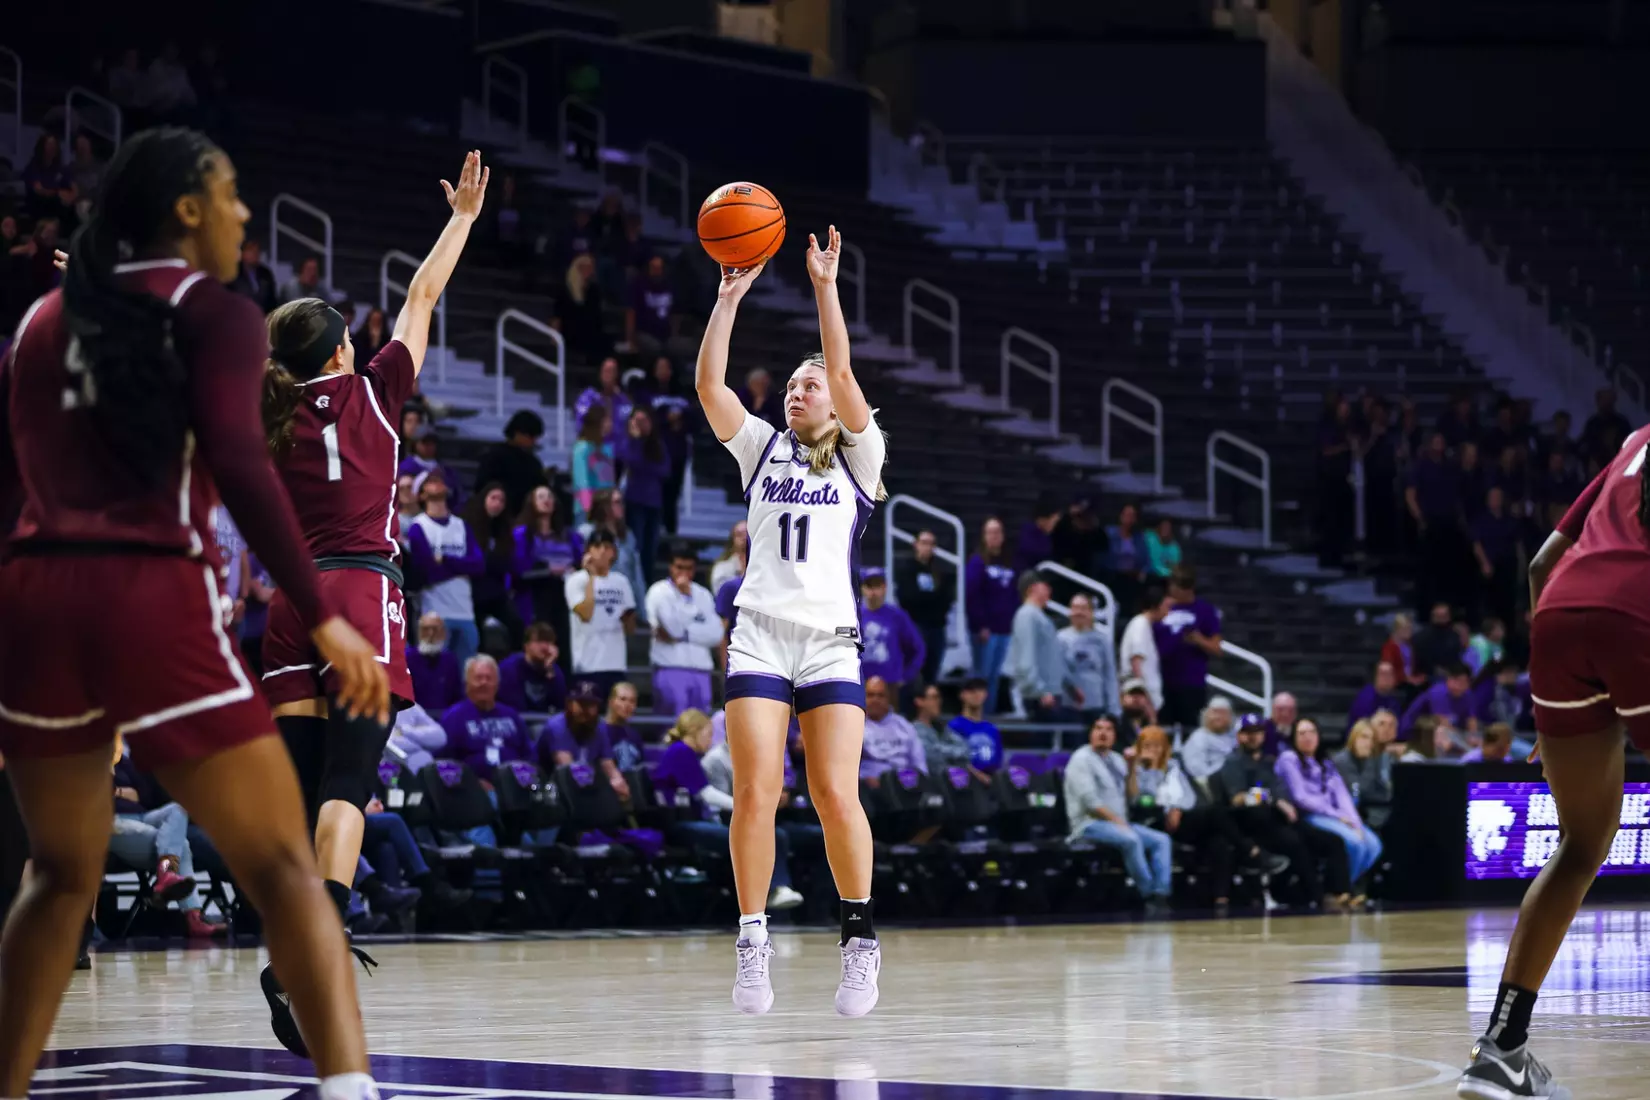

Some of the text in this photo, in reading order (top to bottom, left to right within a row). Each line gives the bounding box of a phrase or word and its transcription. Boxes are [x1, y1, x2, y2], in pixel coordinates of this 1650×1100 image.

[321, 421, 342, 481] 1
[761, 475, 840, 506] Wildcats
[777, 511, 811, 563] 11
